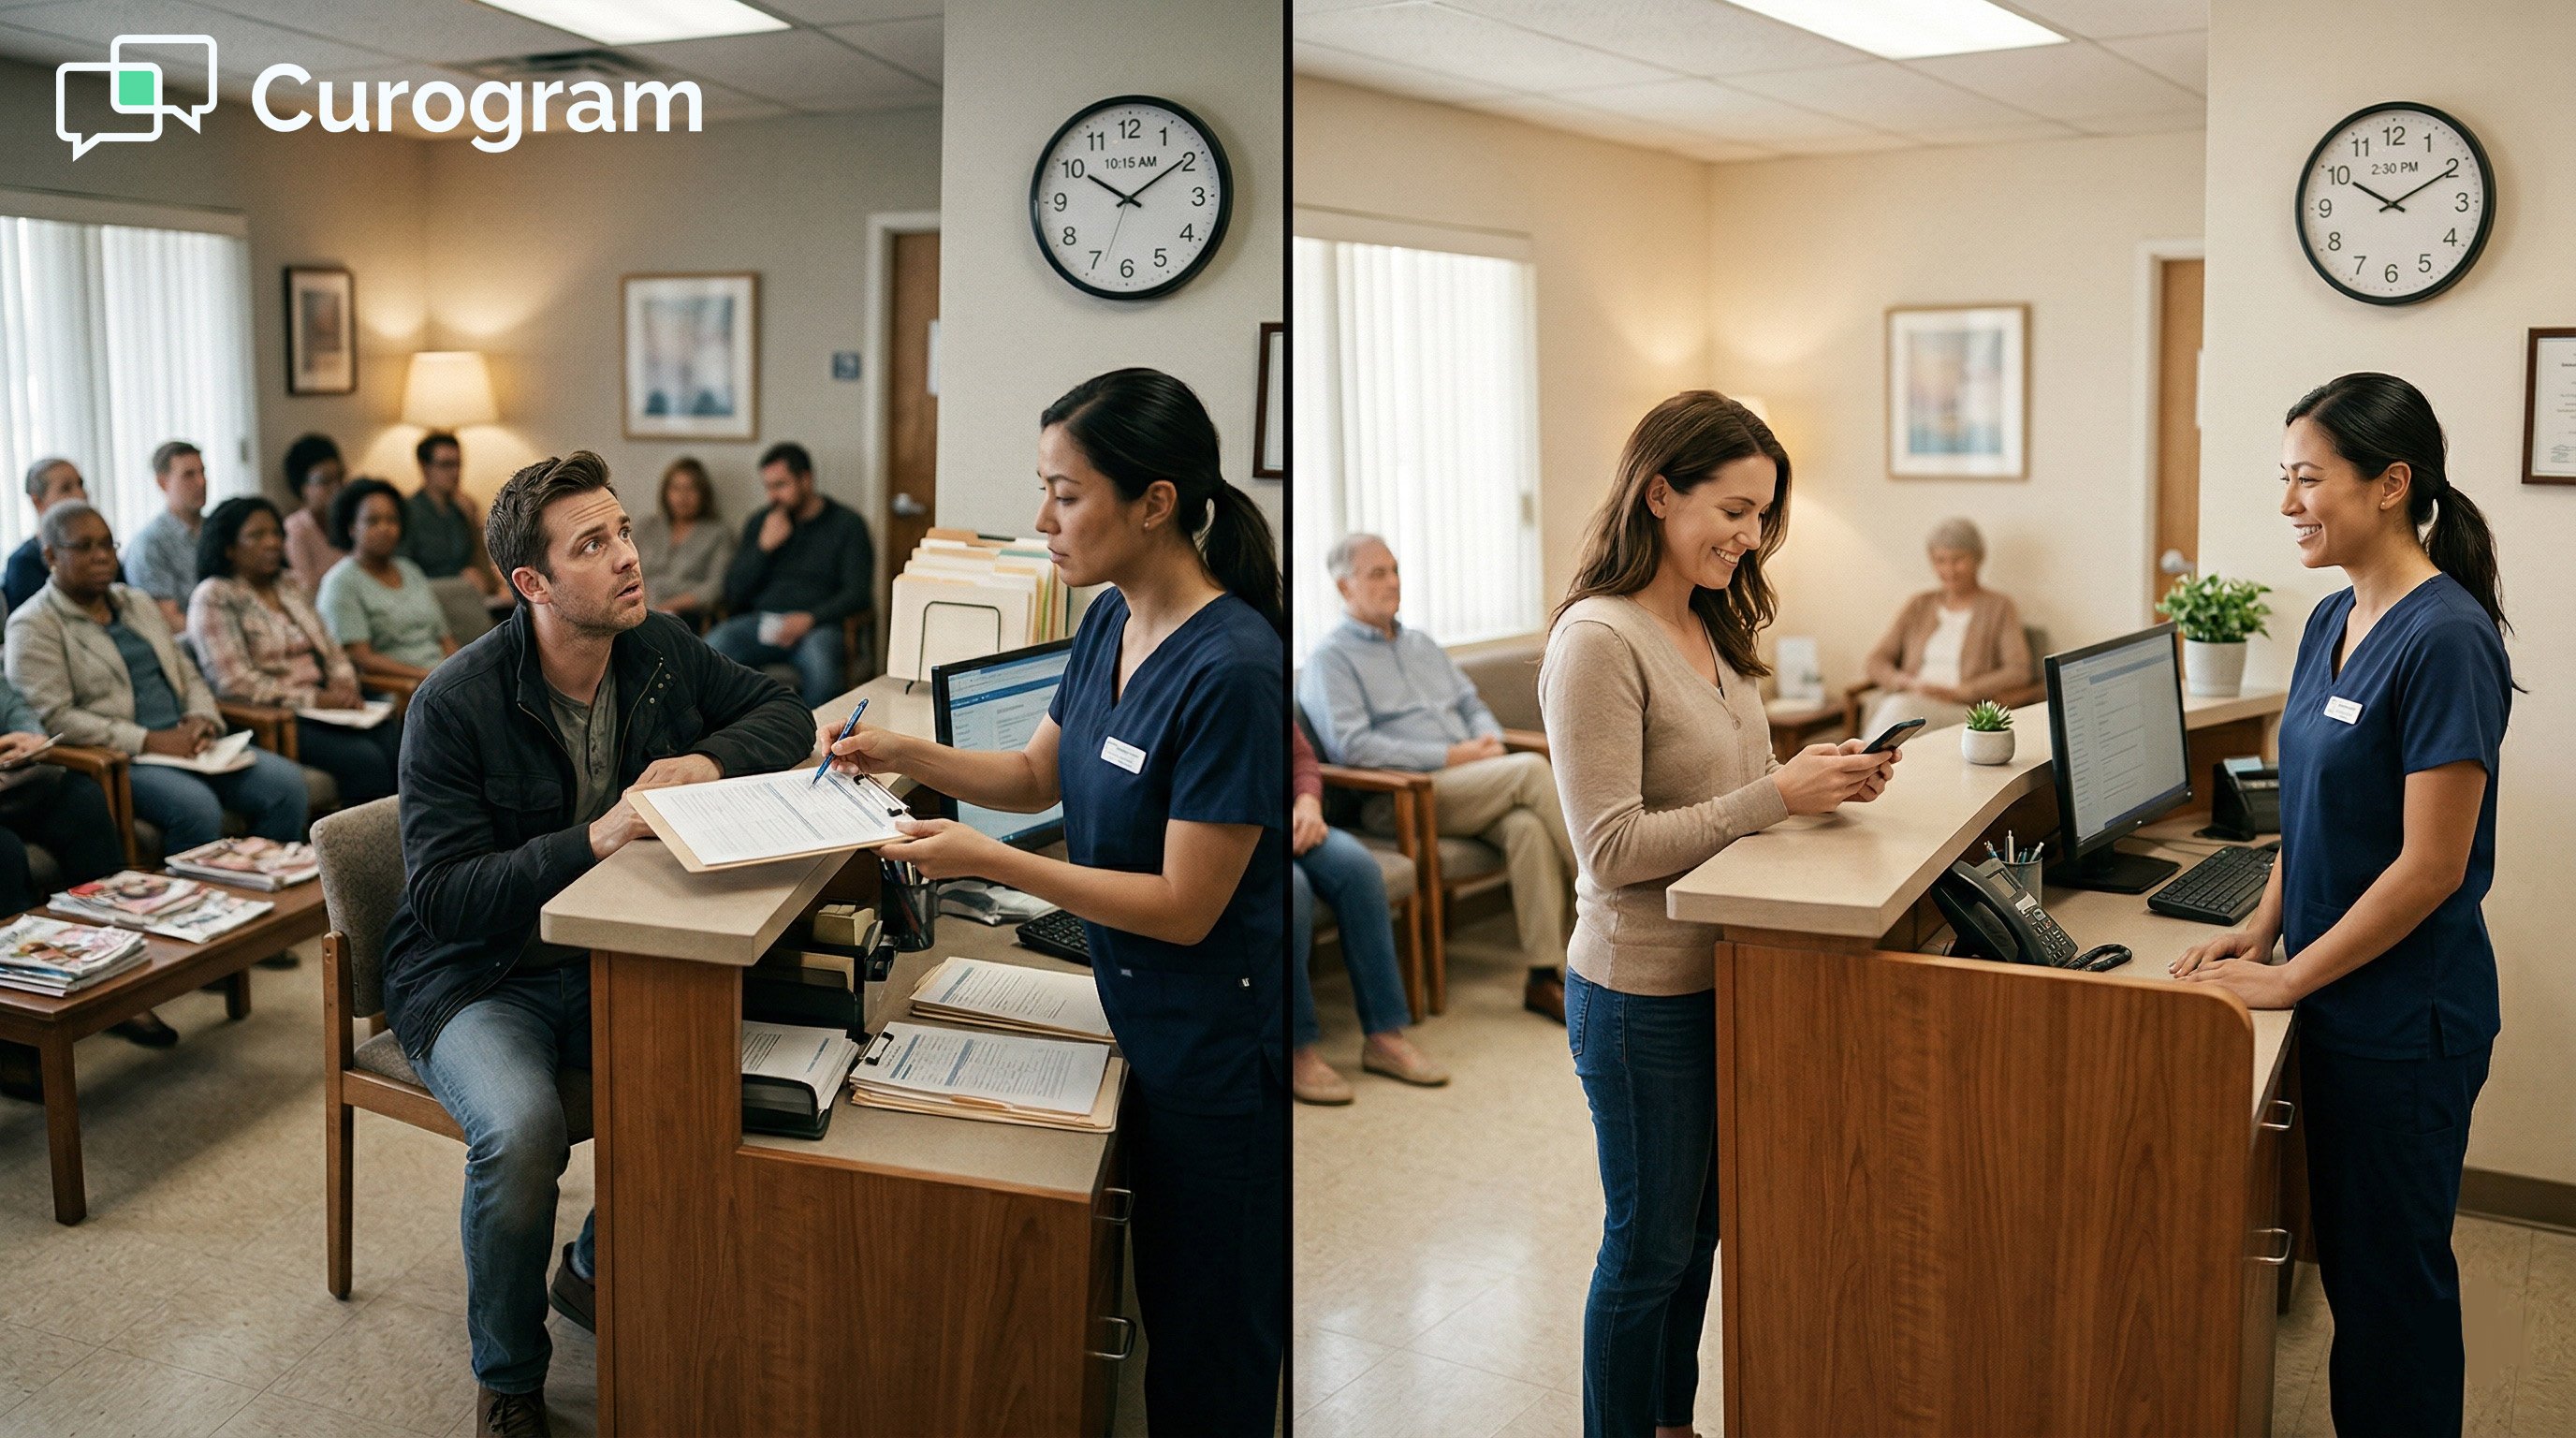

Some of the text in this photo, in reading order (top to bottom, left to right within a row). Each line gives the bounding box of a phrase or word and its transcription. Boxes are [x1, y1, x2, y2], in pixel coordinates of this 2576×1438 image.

[1118, 118, 1141, 139] 12
[1159, 126, 1167, 146] 1
[2382, 125, 2406, 146] 12
[1087, 131, 1105, 152] 11
[2351, 138, 2369, 157] 11
[2423, 133, 2431, 153] 1
[1061, 158, 1085, 179] 10
[1105, 156, 1157, 169] 10:15 AM
[1181, 152, 1196, 172] 2
[2371, 161, 2419, 175] 2:30 PM
[2445, 157, 2459, 178] 2
[2327, 165, 2350, 185] 10
[1054, 192, 1067, 213] 9
[1191, 187, 1206, 207] 3
[2454, 192, 2469, 213] 3
[2319, 198, 2332, 218] 9
[1062, 227, 1076, 246] 8
[1179, 223, 1194, 242] 4
[2327, 231, 2342, 251] 8
[2442, 227, 2458, 247] 4
[1089, 250, 1103, 270] 7
[1120, 258, 1134, 278] 6
[1153, 248, 1167, 268] 5
[2353, 256, 2366, 275] 7
[2418, 254, 2432, 273] 5
[2384, 263, 2399, 283] 6
